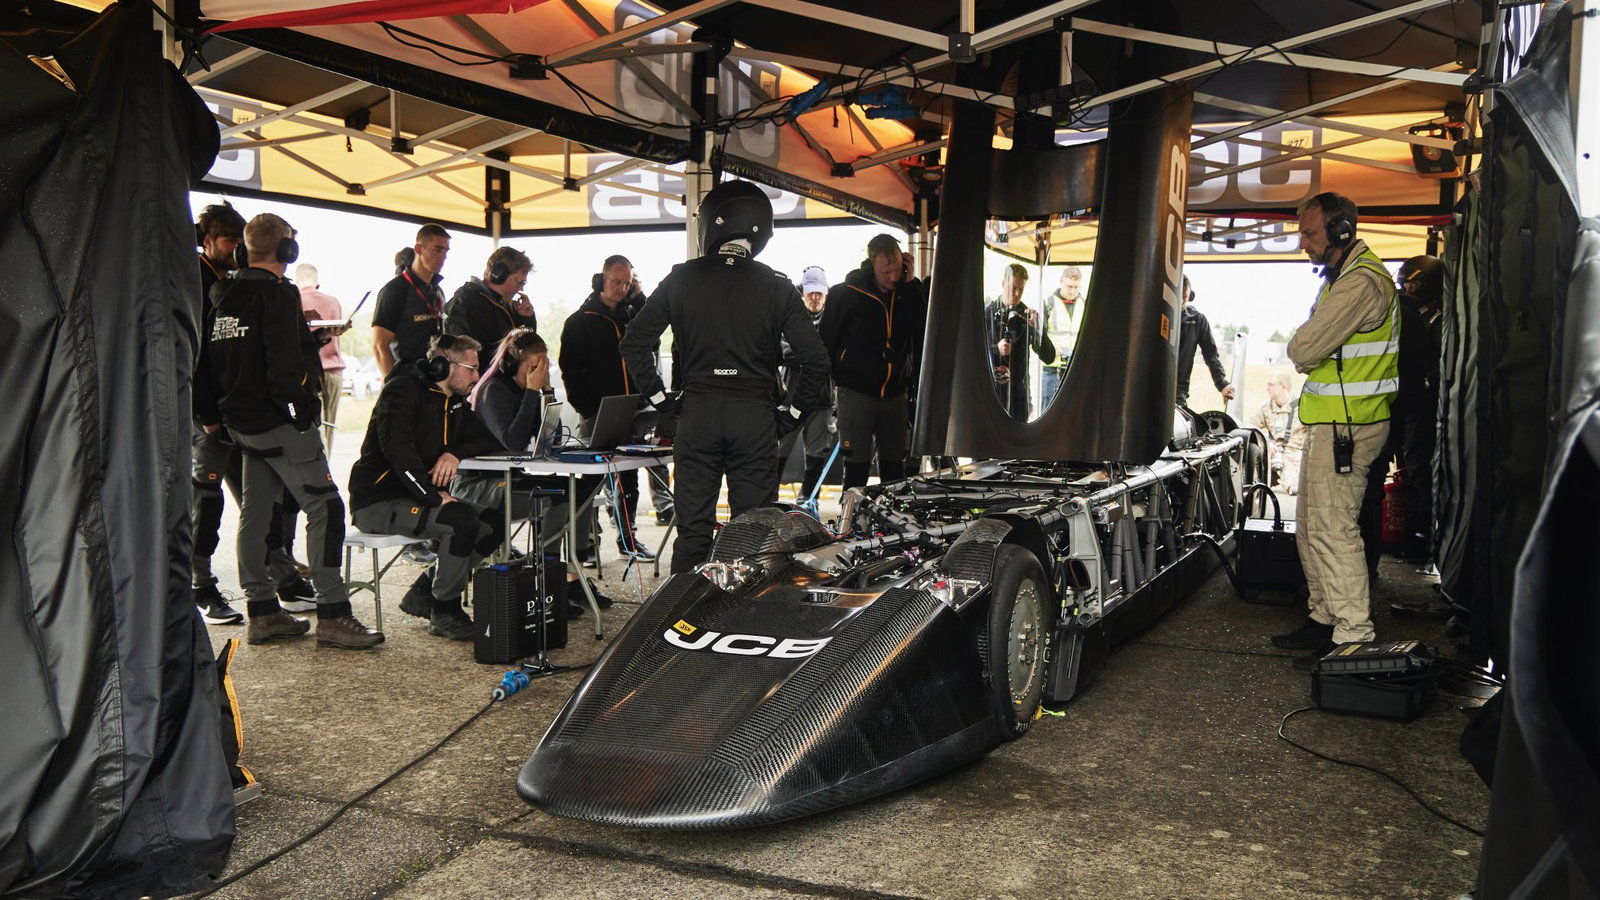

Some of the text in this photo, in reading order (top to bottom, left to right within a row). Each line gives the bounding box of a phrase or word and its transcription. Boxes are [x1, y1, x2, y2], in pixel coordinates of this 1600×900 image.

[1162, 145, 1187, 347] JCB
[211, 326, 249, 341] ONTENT
[713, 368, 738, 376] sparco
[526, 595, 553, 612] po
[663, 628, 834, 659] JCB
